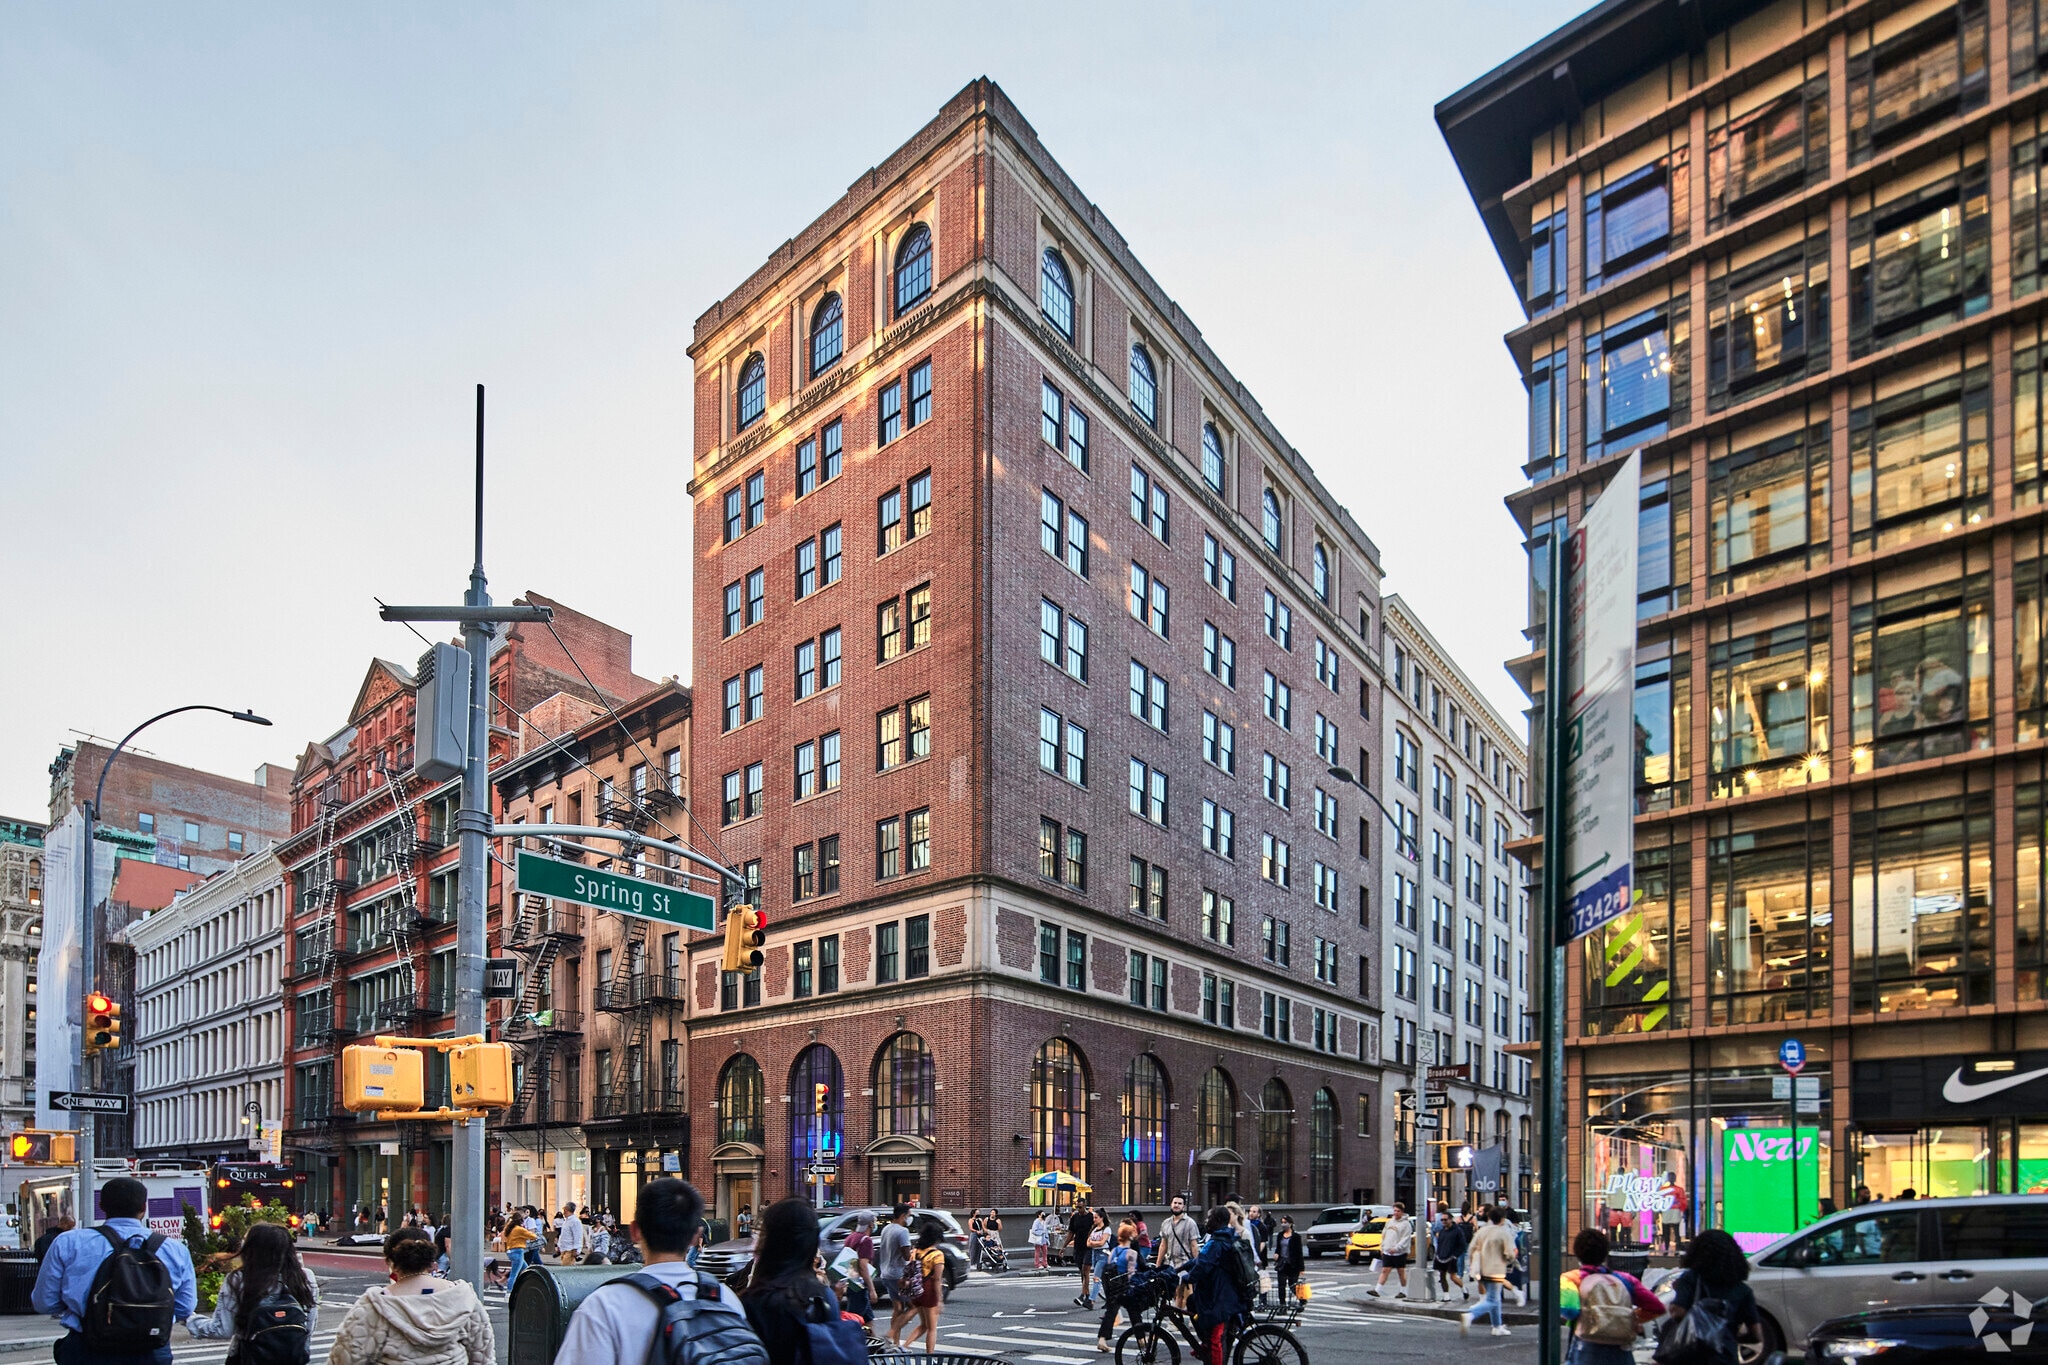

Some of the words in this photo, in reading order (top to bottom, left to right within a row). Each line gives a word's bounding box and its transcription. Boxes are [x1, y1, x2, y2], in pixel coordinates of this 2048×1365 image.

[1570, 531, 1582, 573] 3
[1568, 724, 1579, 763] 2
[574, 874, 643, 913] Spring
[652, 893, 670, 914] St
[492, 970, 510, 986] WAY
[1428, 1069, 1459, 1078] Broadway
[61, 1097, 84, 1106] ONE
[94, 1099, 117, 1107] WAY
[1729, 1132, 1812, 1162] New
[229, 1171, 267, 1182] QUEEN
[1475, 1176, 1496, 1190] alo
[1606, 1171, 1664, 1196] Play
[1623, 1192, 1675, 1212] New
[150, 1219, 180, 1229] SLOW
